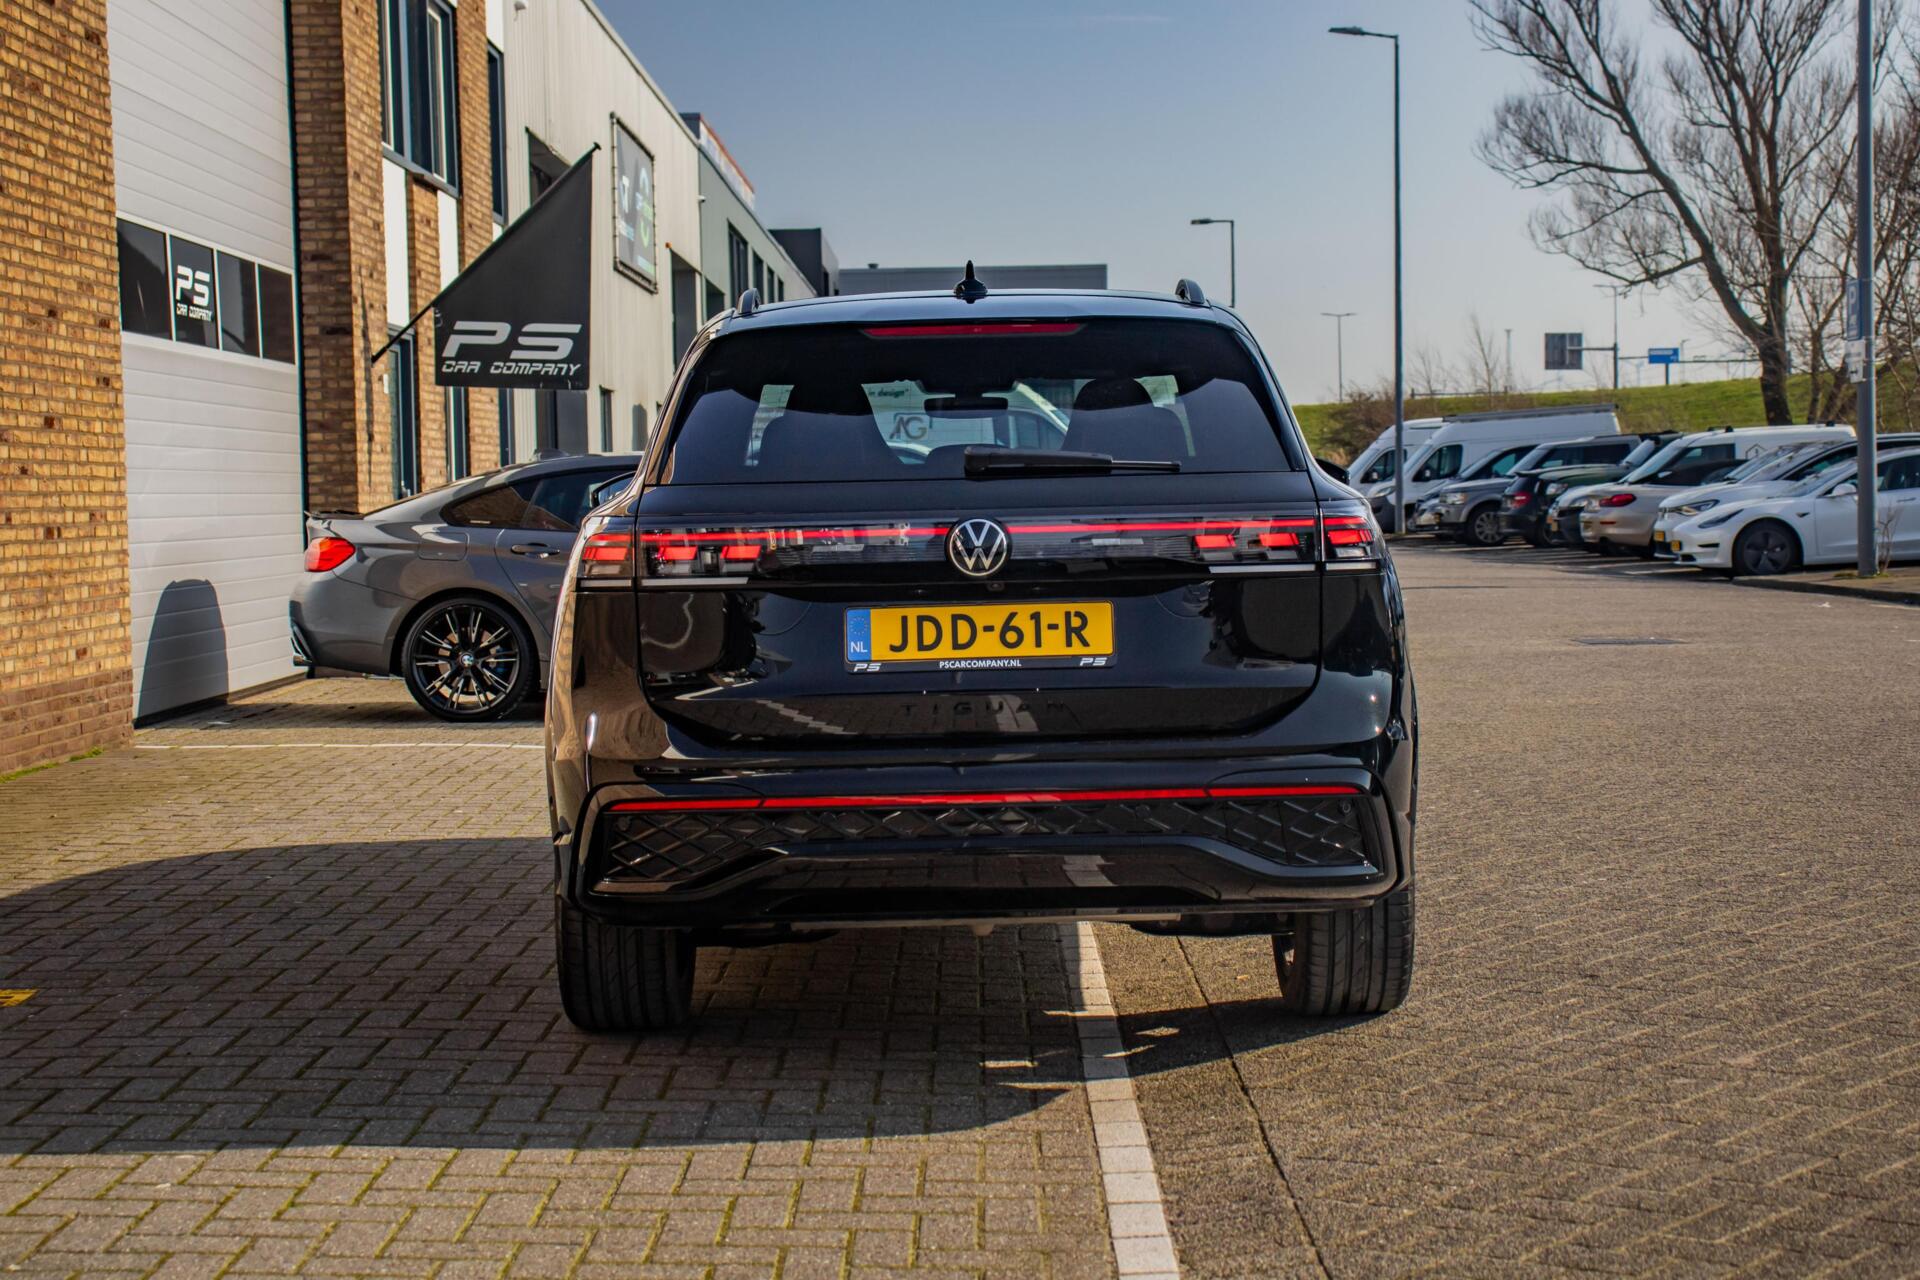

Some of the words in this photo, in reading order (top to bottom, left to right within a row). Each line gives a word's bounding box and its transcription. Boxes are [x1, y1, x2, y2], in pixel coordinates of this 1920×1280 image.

[176, 265, 210, 307] PS
[189, 305, 212, 321] COMPANY
[442, 320, 583, 360] PS
[441, 360, 482, 374] CAR
[489, 361, 581, 376] COMPANY
[850, 641, 868, 653] NL
[889, 610, 1090, 652] JDD-61-R
[853, 662, 882, 672] PS
[939, 658, 1022, 669] PSCARCOMPANY.NL
[1079, 656, 1108, 667] PS
[902, 700, 1064, 716] TIGUAN
